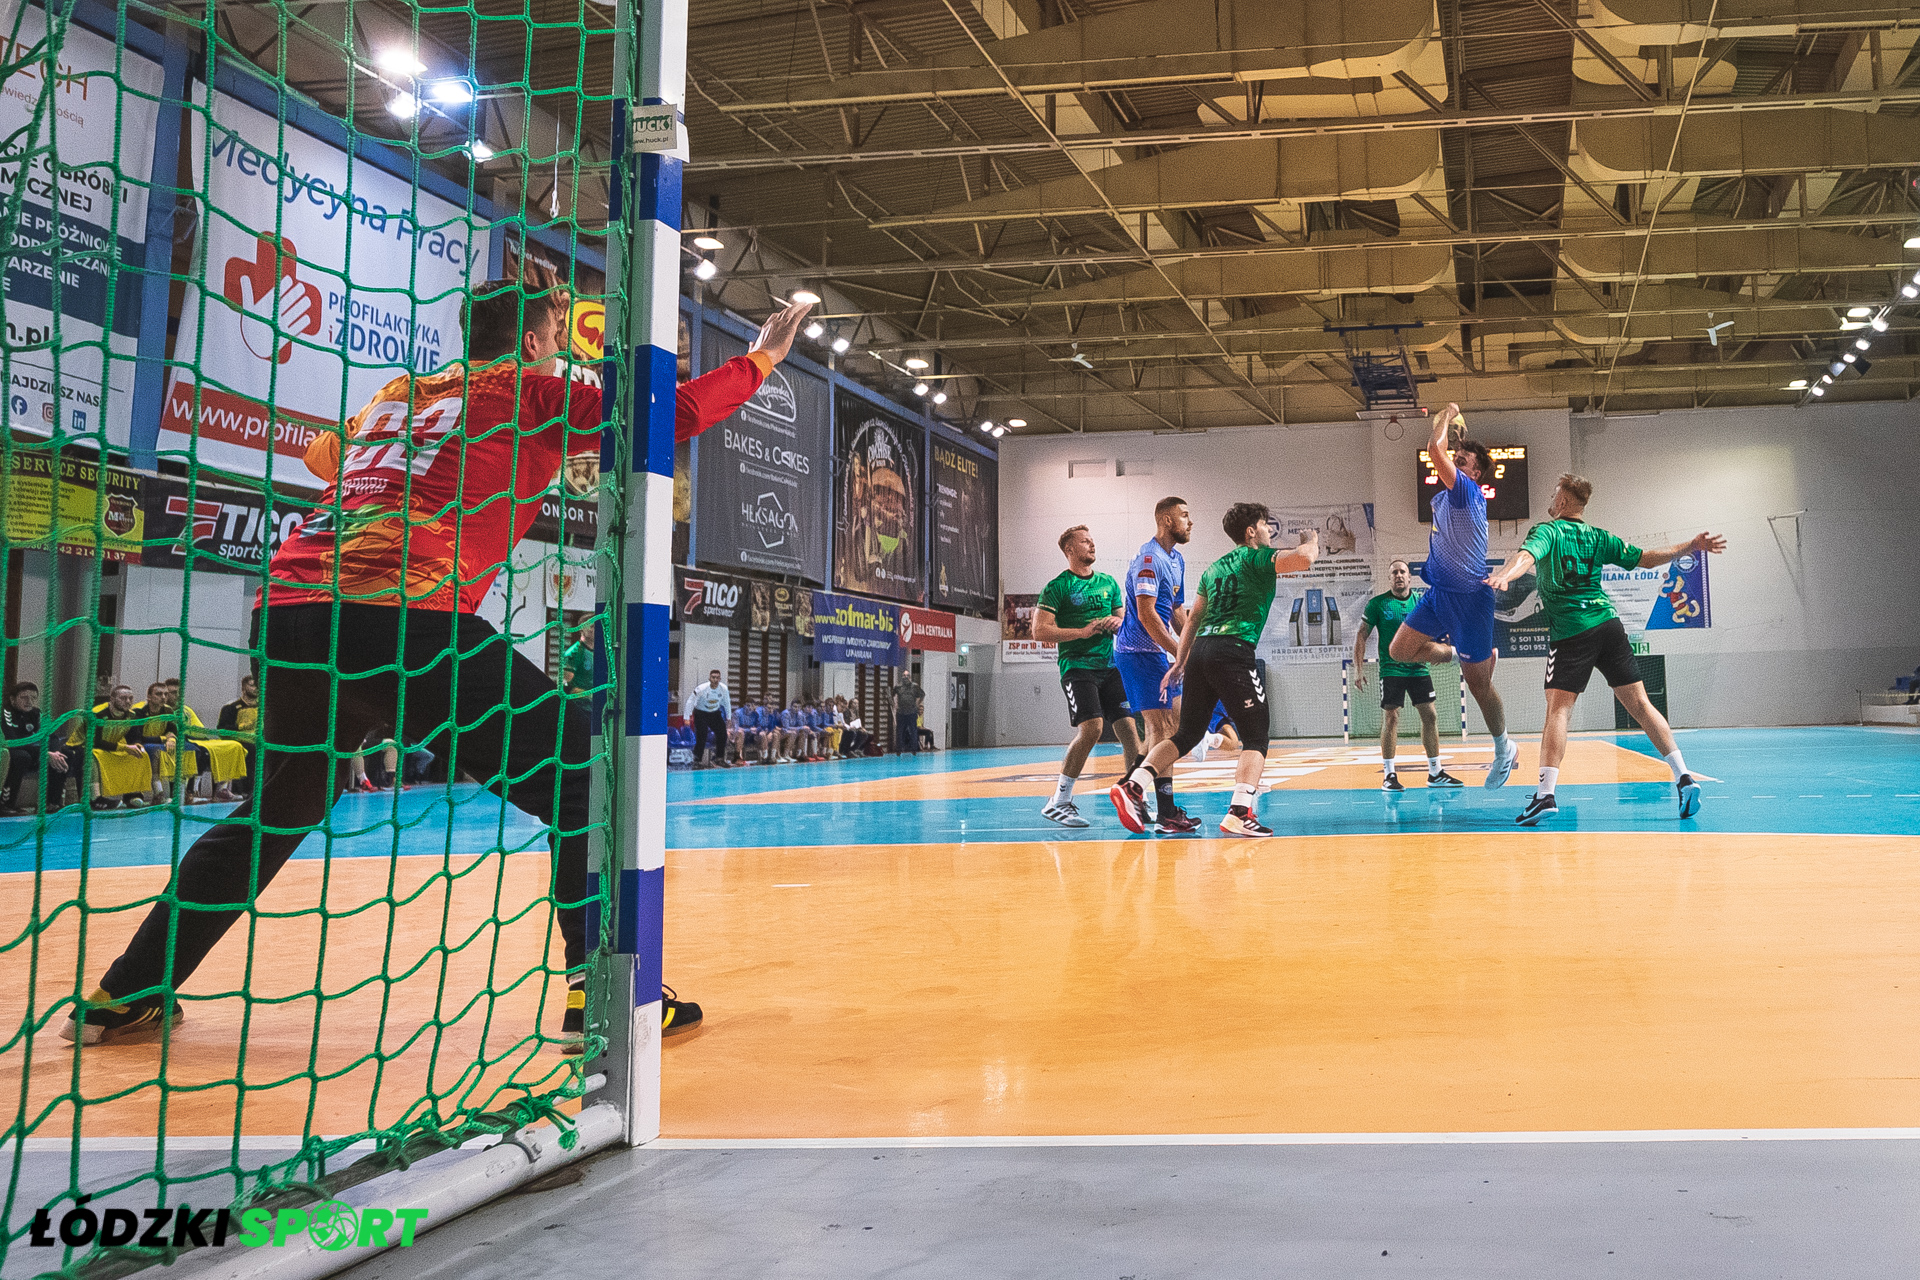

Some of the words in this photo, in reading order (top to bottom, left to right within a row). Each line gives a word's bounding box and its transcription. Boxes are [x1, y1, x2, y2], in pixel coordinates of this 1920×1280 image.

[634, 136, 669, 145] ww.huck.pl
[396, 206, 480, 277] Pracy
[7, 256, 79, 289] ARZENIE
[171, 397, 324, 448] www.profila
[724, 428, 763, 459] BAKES
[764, 447, 771, 462] &
[772, 446, 810, 475] CAKES
[11, 456, 76, 478] SERVCE
[80, 466, 141, 490] SEURITY
[957, 456, 978, 479] ELITE!
[741, 502, 798, 533] HEKSAGON
[1634, 570, 1660, 580] ŁÓDŹ
[703, 580, 739, 608] TICO
[913, 622, 925, 636] LIGA
[925, 624, 954, 639] CENTRALNA
